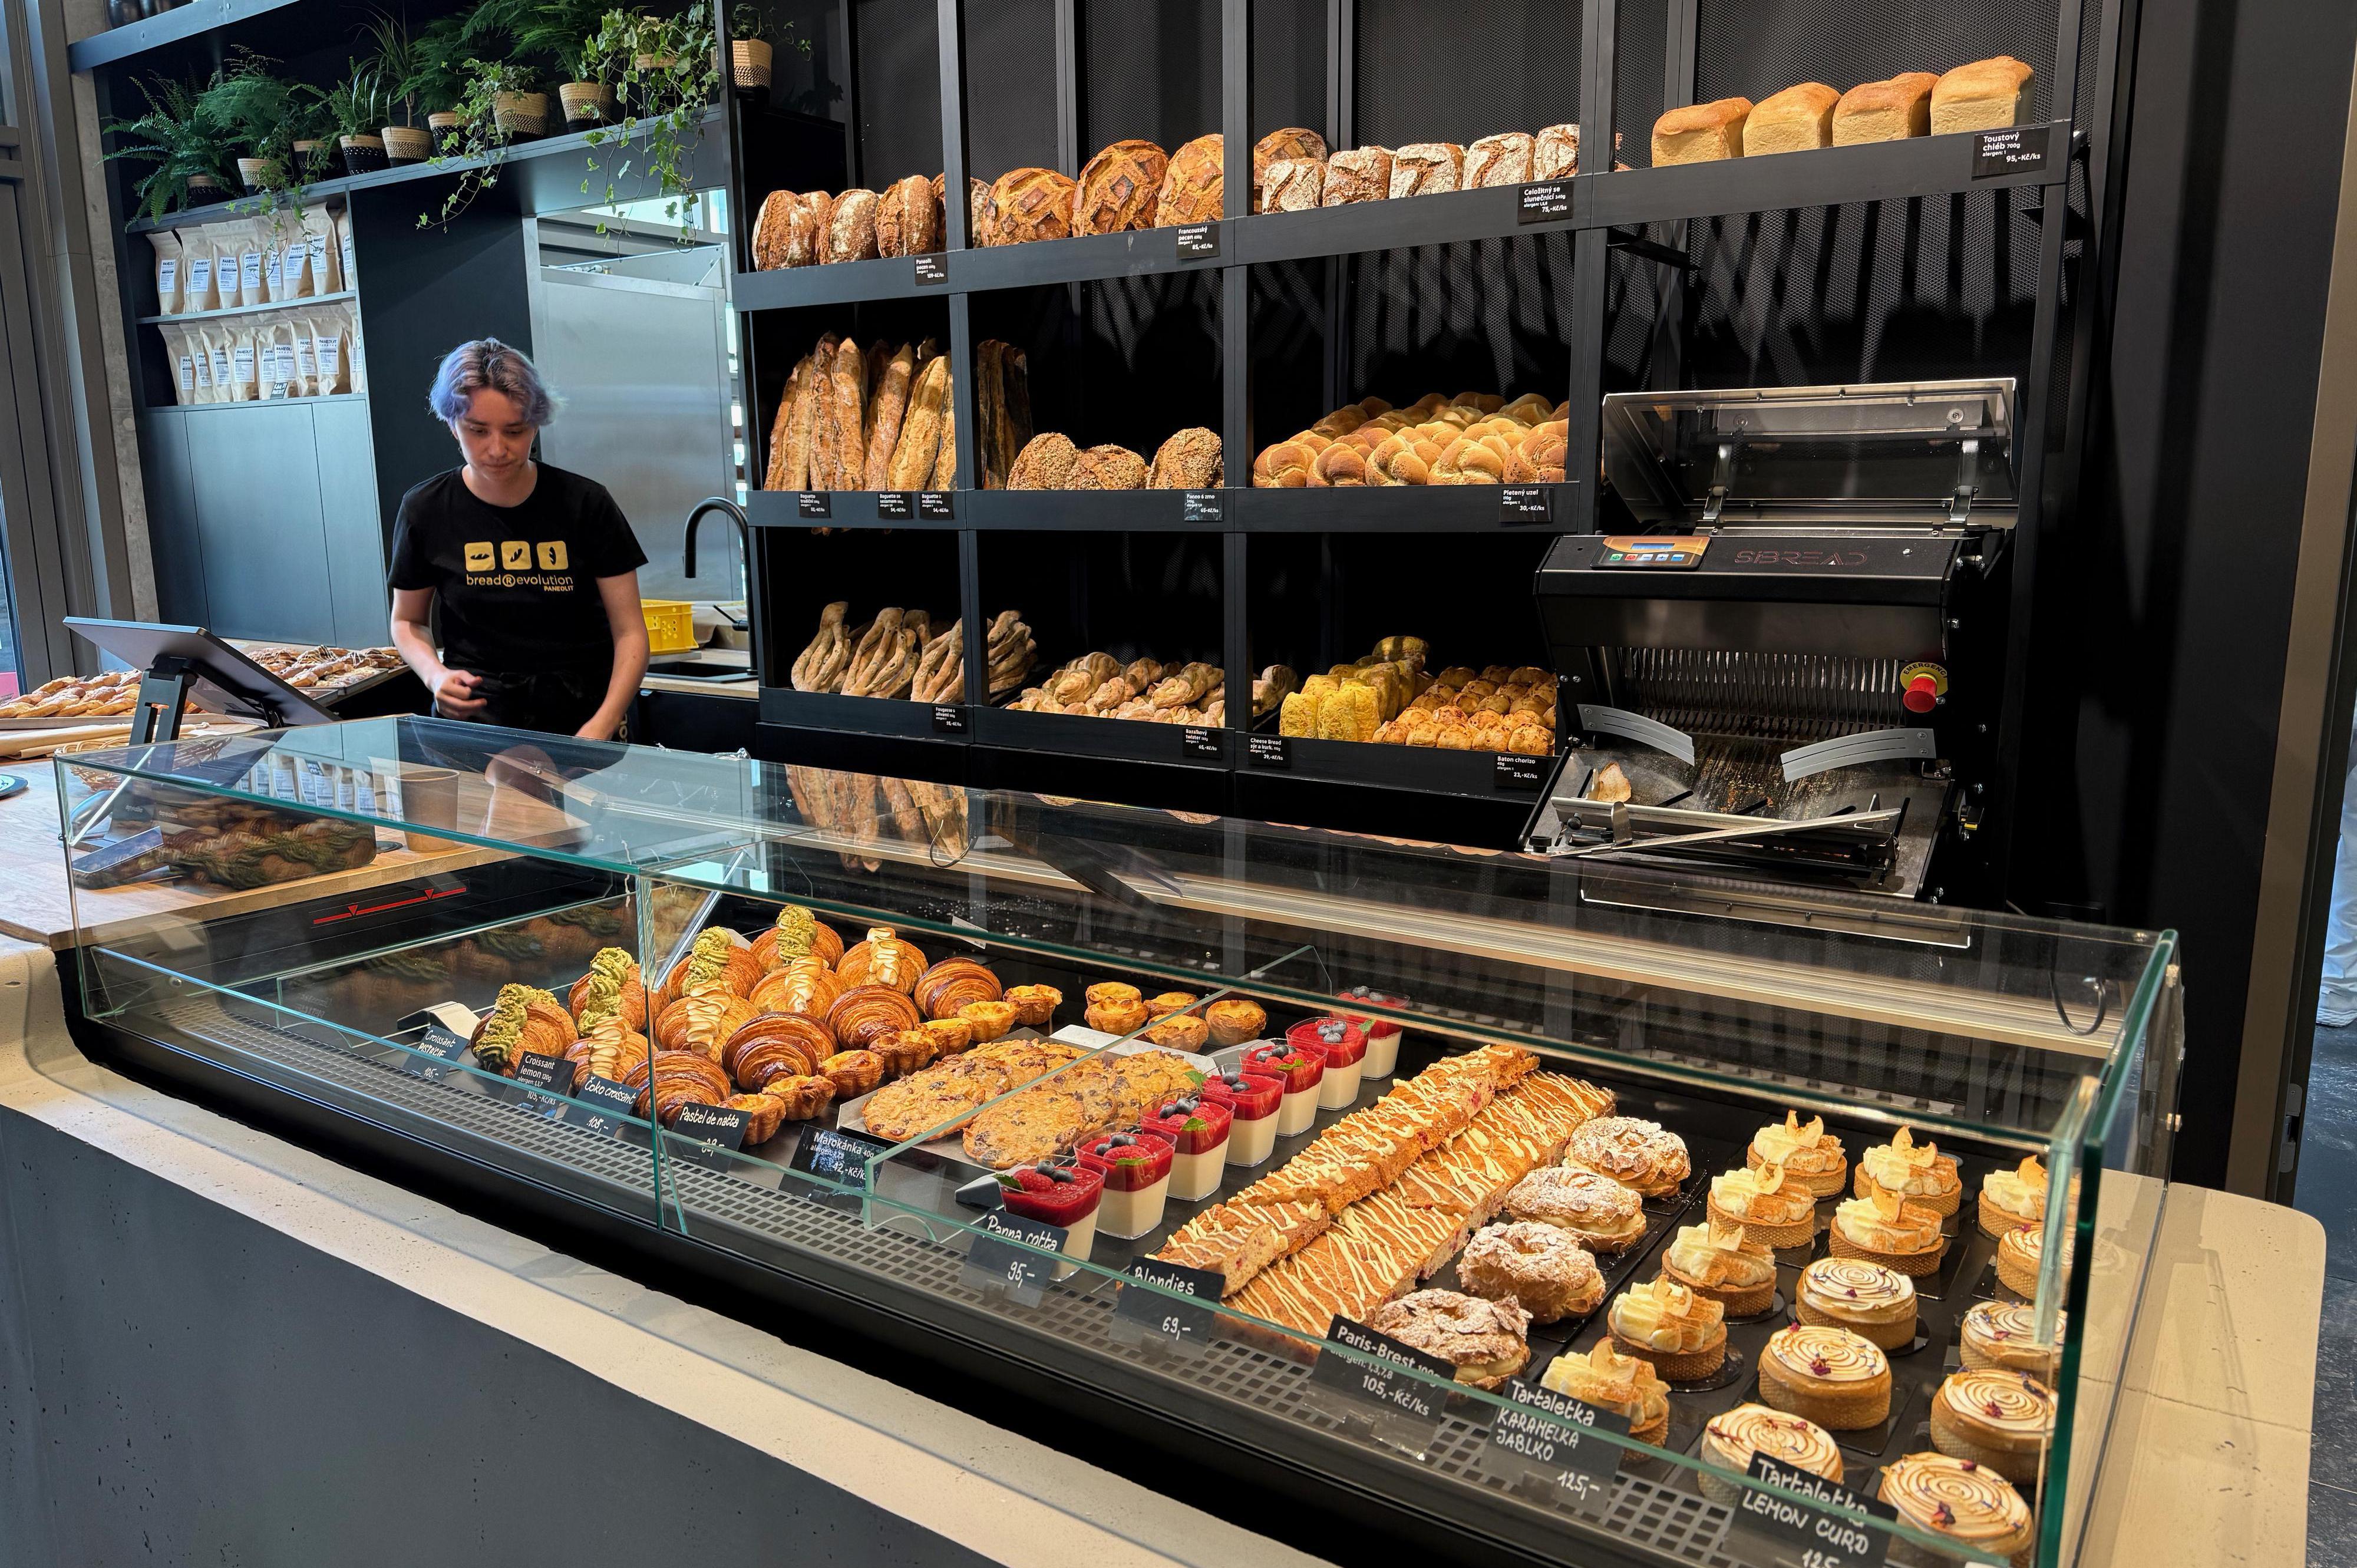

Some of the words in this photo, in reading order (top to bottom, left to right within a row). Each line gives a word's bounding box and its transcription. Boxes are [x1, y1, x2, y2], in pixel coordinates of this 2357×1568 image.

[1983, 131, 2019, 143] Toustový
[1983, 142, 2005, 151] chléb
[2006, 153, 2041, 163] 95,-Kč/ks
[1524, 186, 1552, 196] Celožitný
[1524, 193, 1554, 203] slunečnicí
[1178, 226, 1208, 235] Francouzský
[425, 1029, 456, 1048] Croissant
[520, 1065, 542, 1078] lemon
[542, 1073, 552, 1083] 120g
[525, 1055, 555, 1069] Croissant
[585, 1075, 605, 1095] Čoko
[605, 1087, 636, 1104] croissant
[679, 1106, 708, 1124] Pastel
[706, 1112, 716, 1125] de
[716, 1113, 740, 1128] natta
[814, 1131, 862, 1155] Marokánka
[987, 1214, 1022, 1240] Panna
[1026, 1230, 1058, 1252] cotta
[1008, 1261, 1035, 1289] 95,-
[1131, 1266, 1195, 1296] Blondies
[1162, 1316, 1191, 1341] 69,-
[1336, 1325, 1417, 1369] Paris-Brest
[1362, 1374, 1430, 1417] 105,-Kč/ks
[1512, 1379, 1596, 1427] Tartaletka
[1496, 1428, 1554, 1462] JABLKO
[1557, 1470, 1601, 1501] 125,-
[1757, 1458, 1869, 1529] Tartaletka
[1742, 1489, 1810, 1530] LEMON
[1815, 1517, 1869, 1556] CURD
